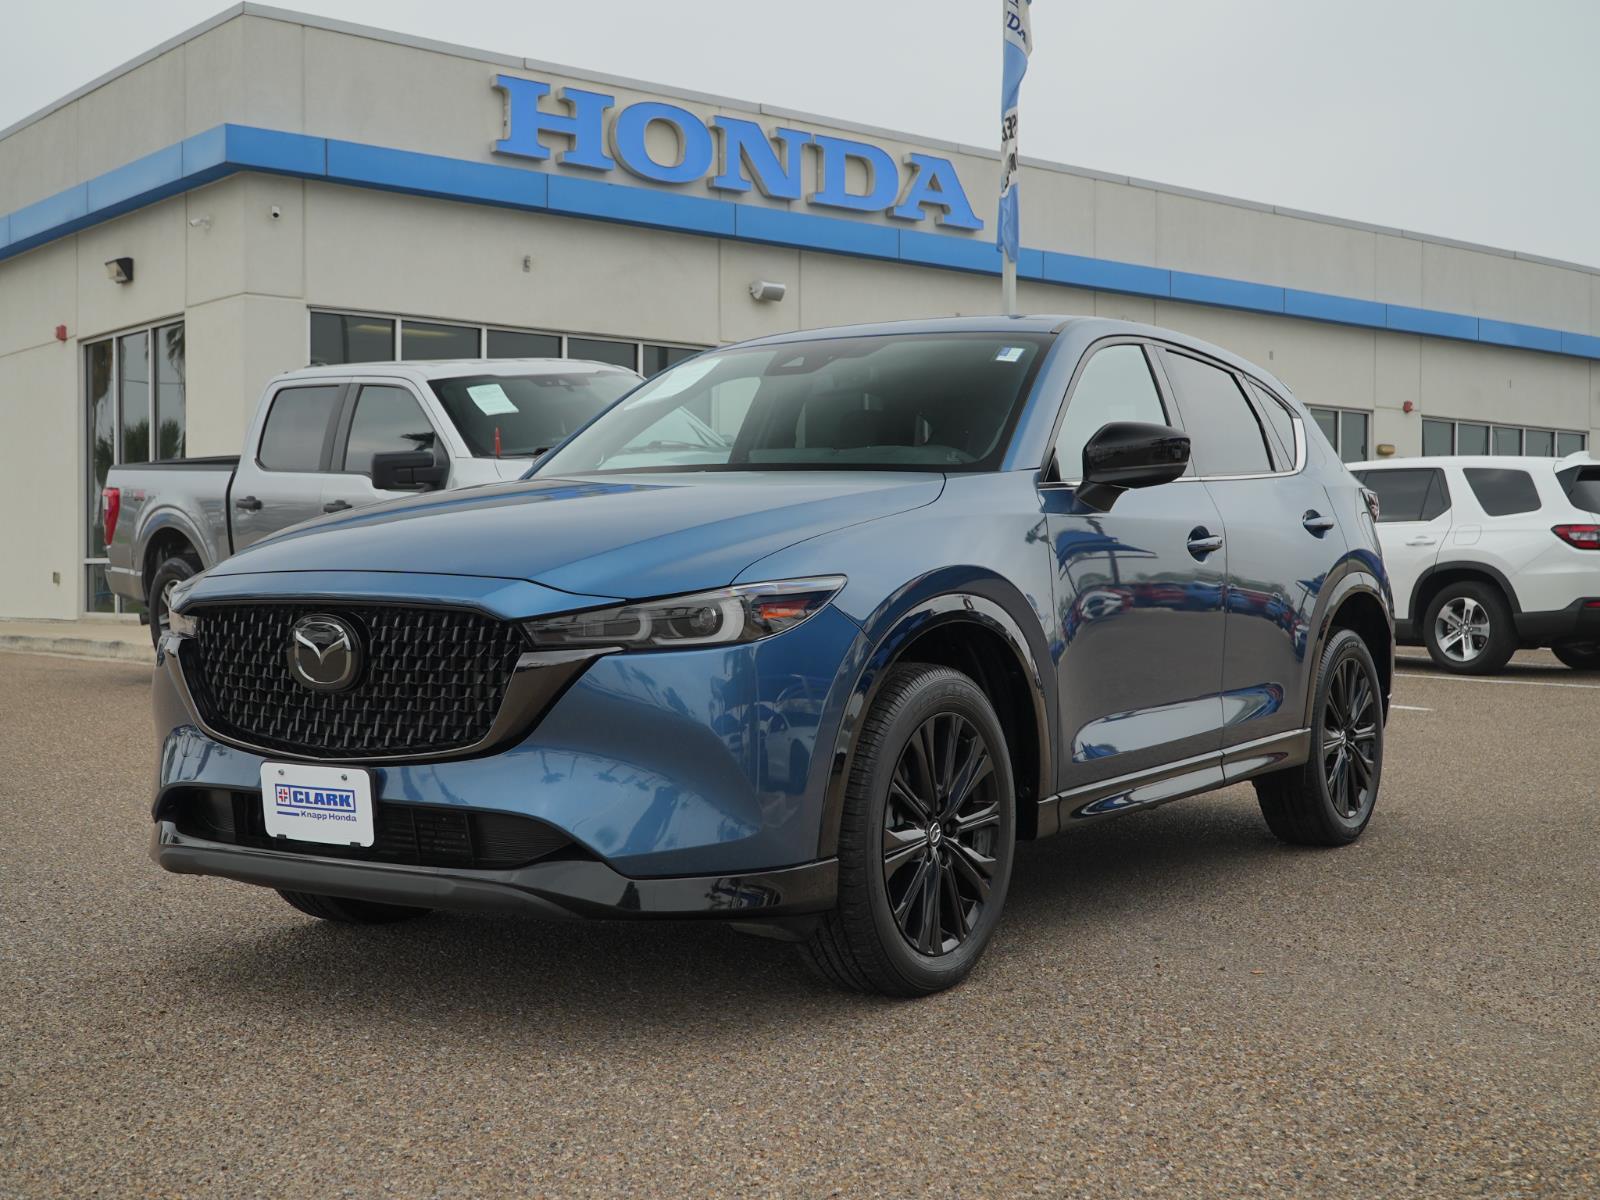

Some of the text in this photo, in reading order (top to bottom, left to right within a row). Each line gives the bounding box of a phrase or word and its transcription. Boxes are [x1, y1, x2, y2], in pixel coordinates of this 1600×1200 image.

[491, 73, 983, 231] HONDA
[292, 790, 351, 808] CLARK
[300, 810, 357, 822] Knapp Honda
